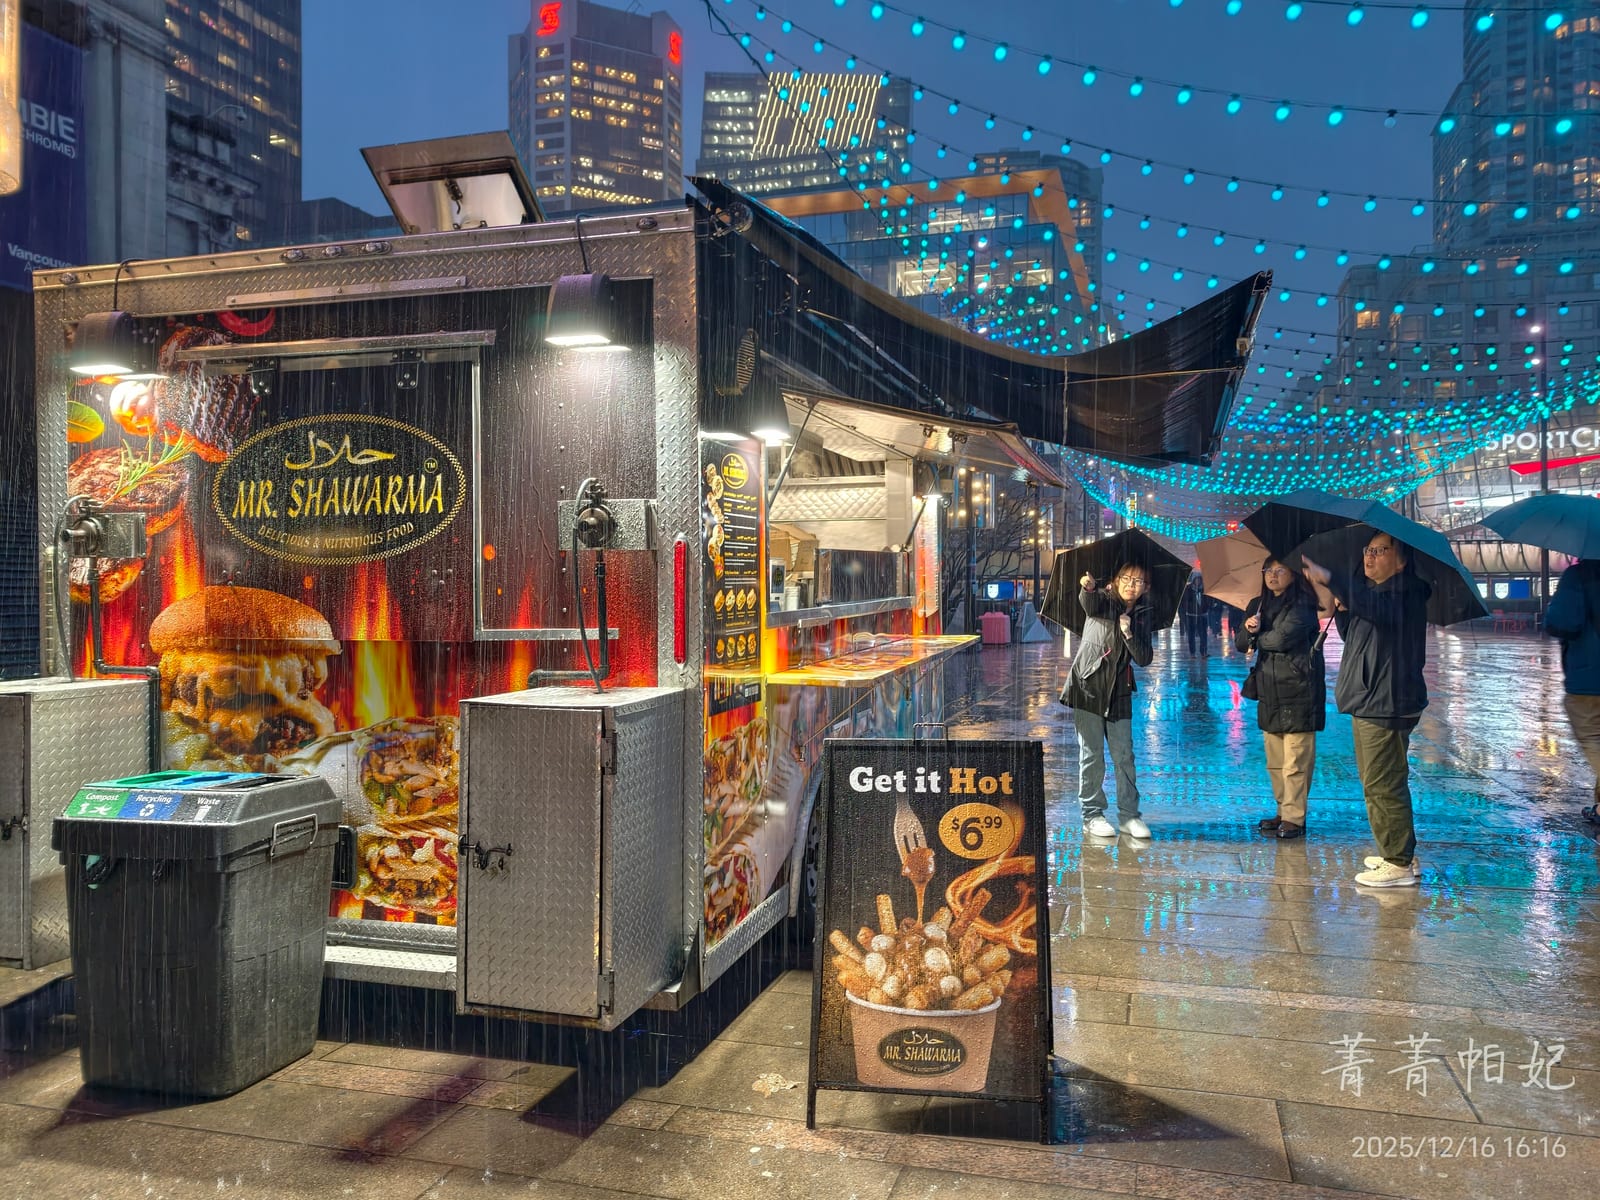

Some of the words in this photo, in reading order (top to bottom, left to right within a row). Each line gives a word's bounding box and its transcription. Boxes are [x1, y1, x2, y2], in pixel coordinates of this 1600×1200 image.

[21, 127, 76, 159] HROME)
[232, 478, 278, 519] MR.
[288, 473, 444, 519] SHAWARMA
[258, 524, 311, 548] DELICIOUS
[312, 536, 320, 549] &
[322, 531, 384, 549] NUTRITIOUS
[386, 521, 414, 541] FOOD
[849, 766, 907, 794] Get
[914, 766, 941, 794] it
[948, 767, 1014, 795] Hot
[85, 792, 119, 802] Compost
[136, 794, 173, 804] Recycling
[197, 797, 221, 806] Waste
[883, 1045, 902, 1060] MR.
[904, 1046, 961, 1062] SHAWARMA
